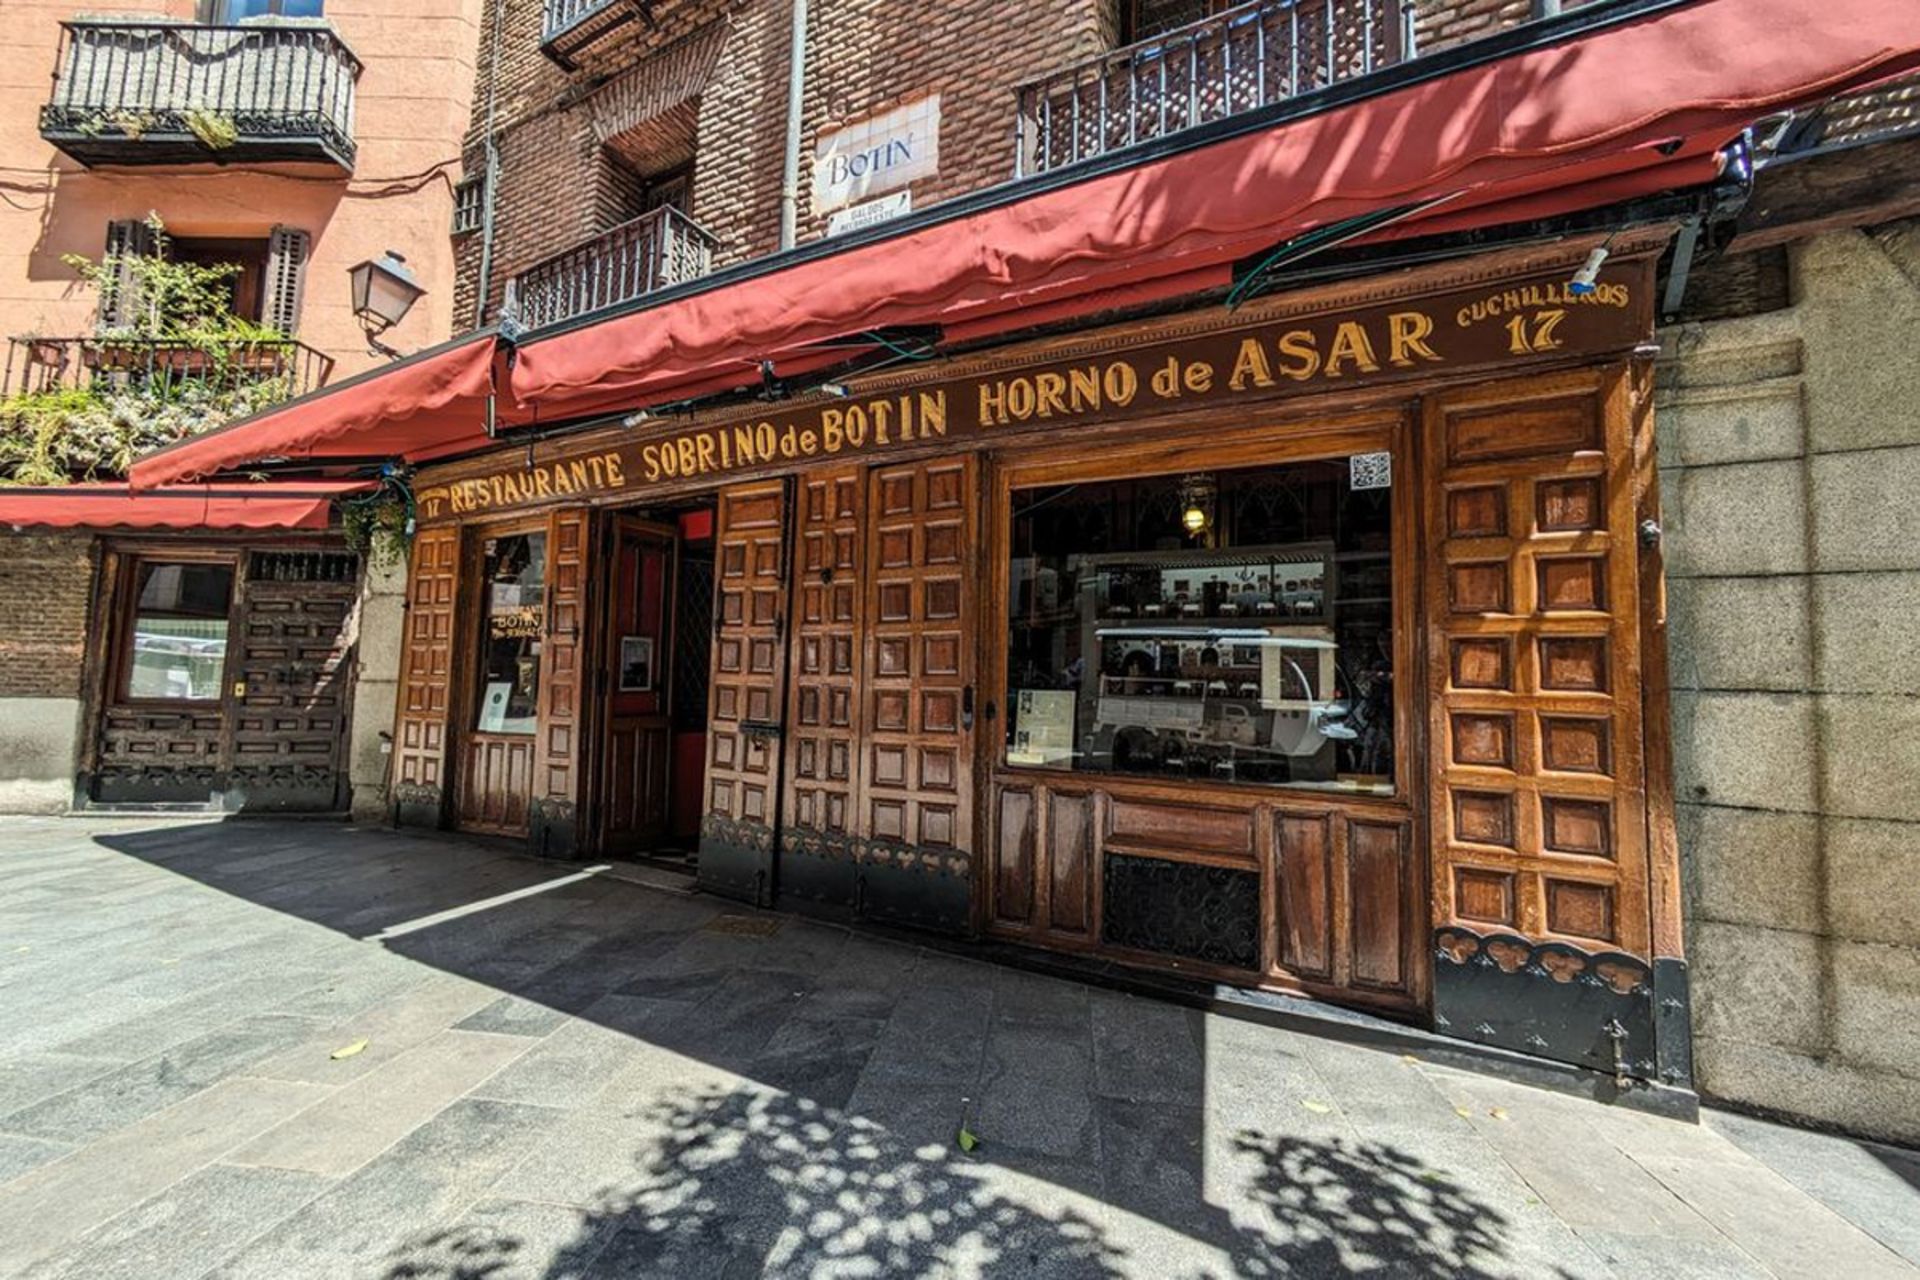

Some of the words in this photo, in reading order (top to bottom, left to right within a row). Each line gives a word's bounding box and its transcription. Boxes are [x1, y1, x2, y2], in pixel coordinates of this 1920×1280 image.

[1505, 309, 1566, 355] 17
[451, 453, 624, 513] RESTAURANTE
[643, 422, 776, 482] SOBRINO
[780, 425, 818, 458] de
[822, 390, 947, 452] BOTIN
[978, 361, 1138, 428] HORNO
[1152, 355, 1213, 398] de
[1228, 311, 1446, 391] ASAR
